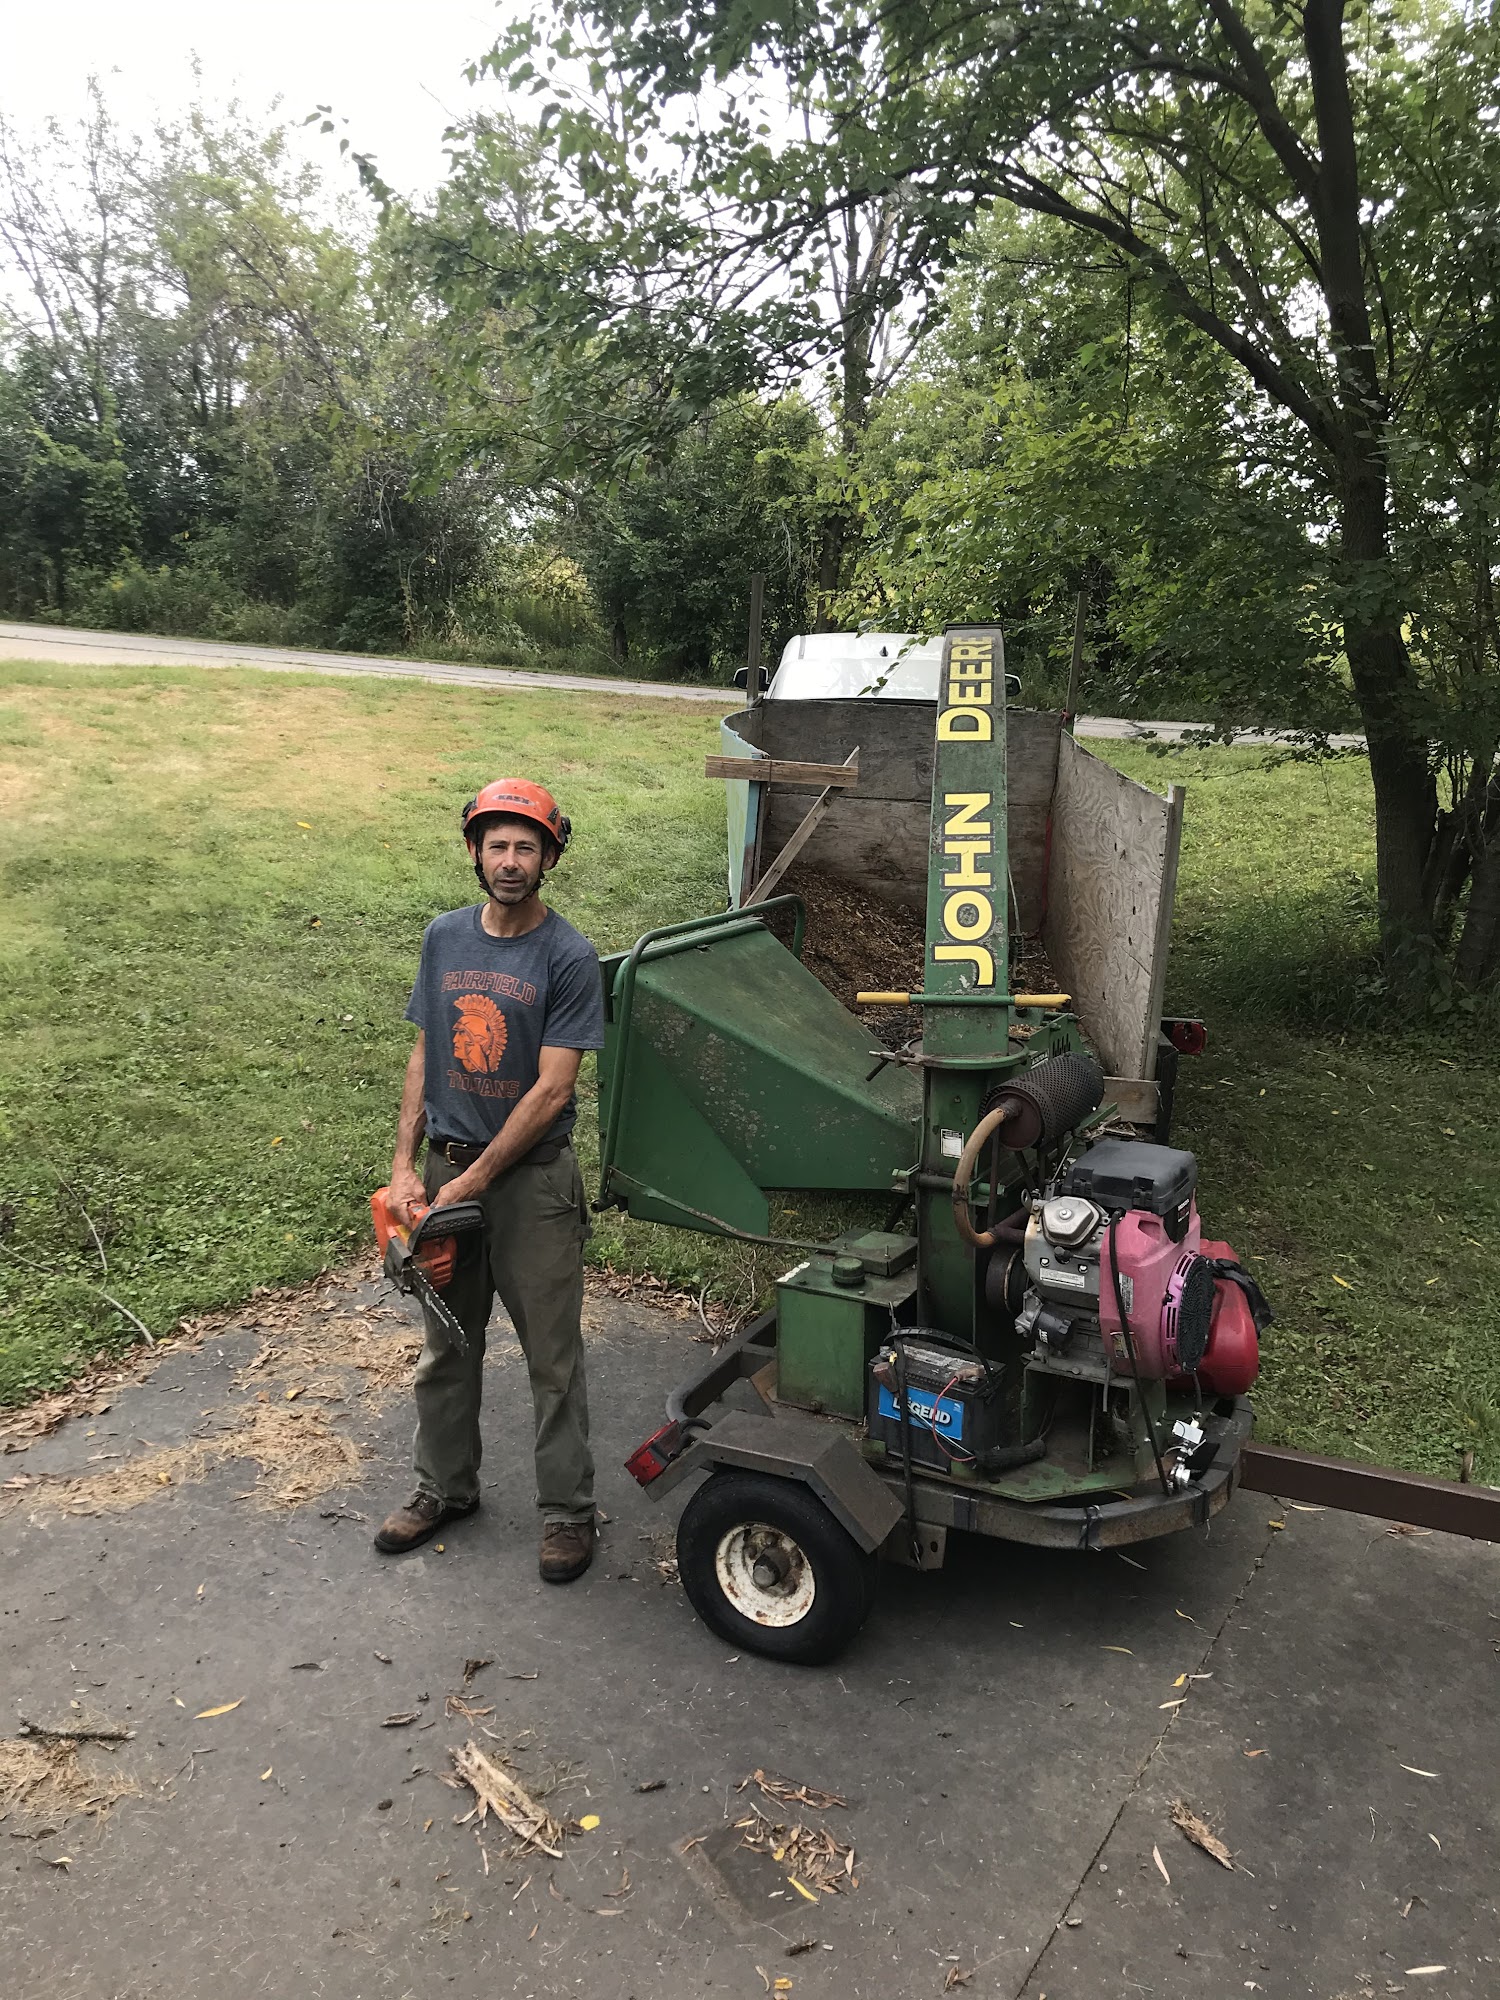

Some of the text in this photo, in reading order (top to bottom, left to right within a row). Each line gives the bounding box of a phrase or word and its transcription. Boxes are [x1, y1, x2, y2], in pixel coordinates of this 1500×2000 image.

[934, 635, 994, 986] JOHN DEERE
[441, 970, 537, 1006] FAIRFIELD
[892, 1397, 951, 1425] LGEND
